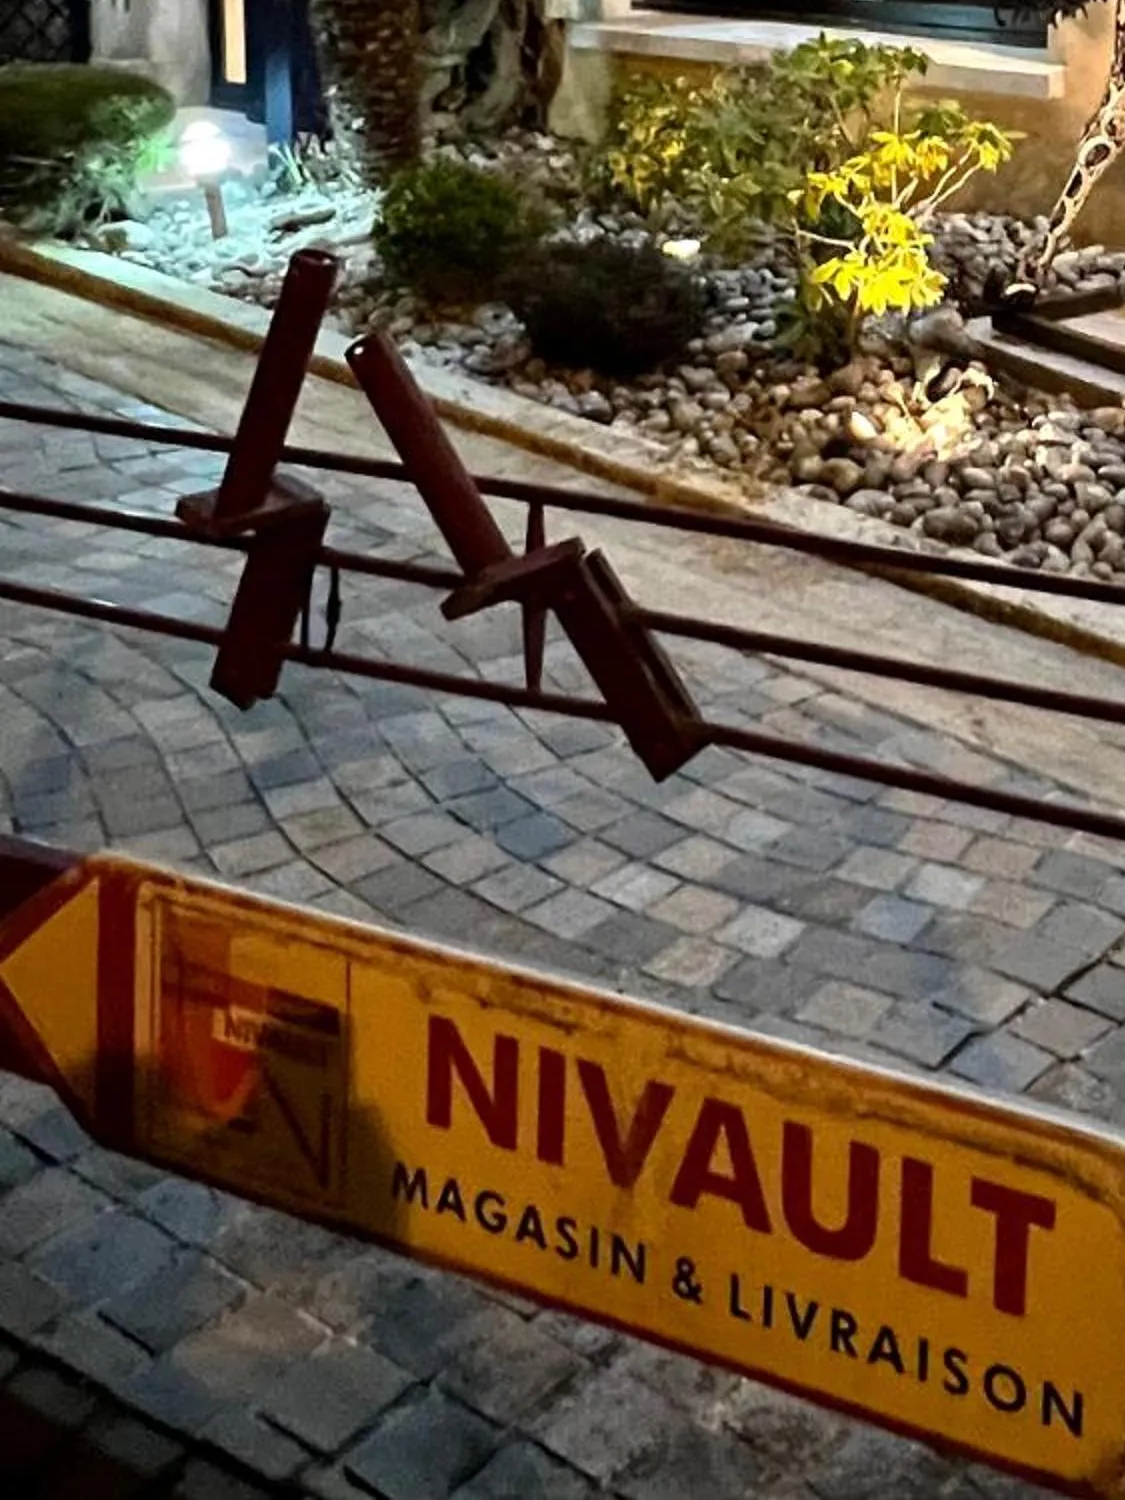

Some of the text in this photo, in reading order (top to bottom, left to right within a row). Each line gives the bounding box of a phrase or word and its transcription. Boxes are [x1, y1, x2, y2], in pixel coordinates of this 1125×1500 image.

[392, 1161, 1084, 1438] MAGASIN & LIVRAISON
[427, 1014, 1056, 1316] NIVAULT
